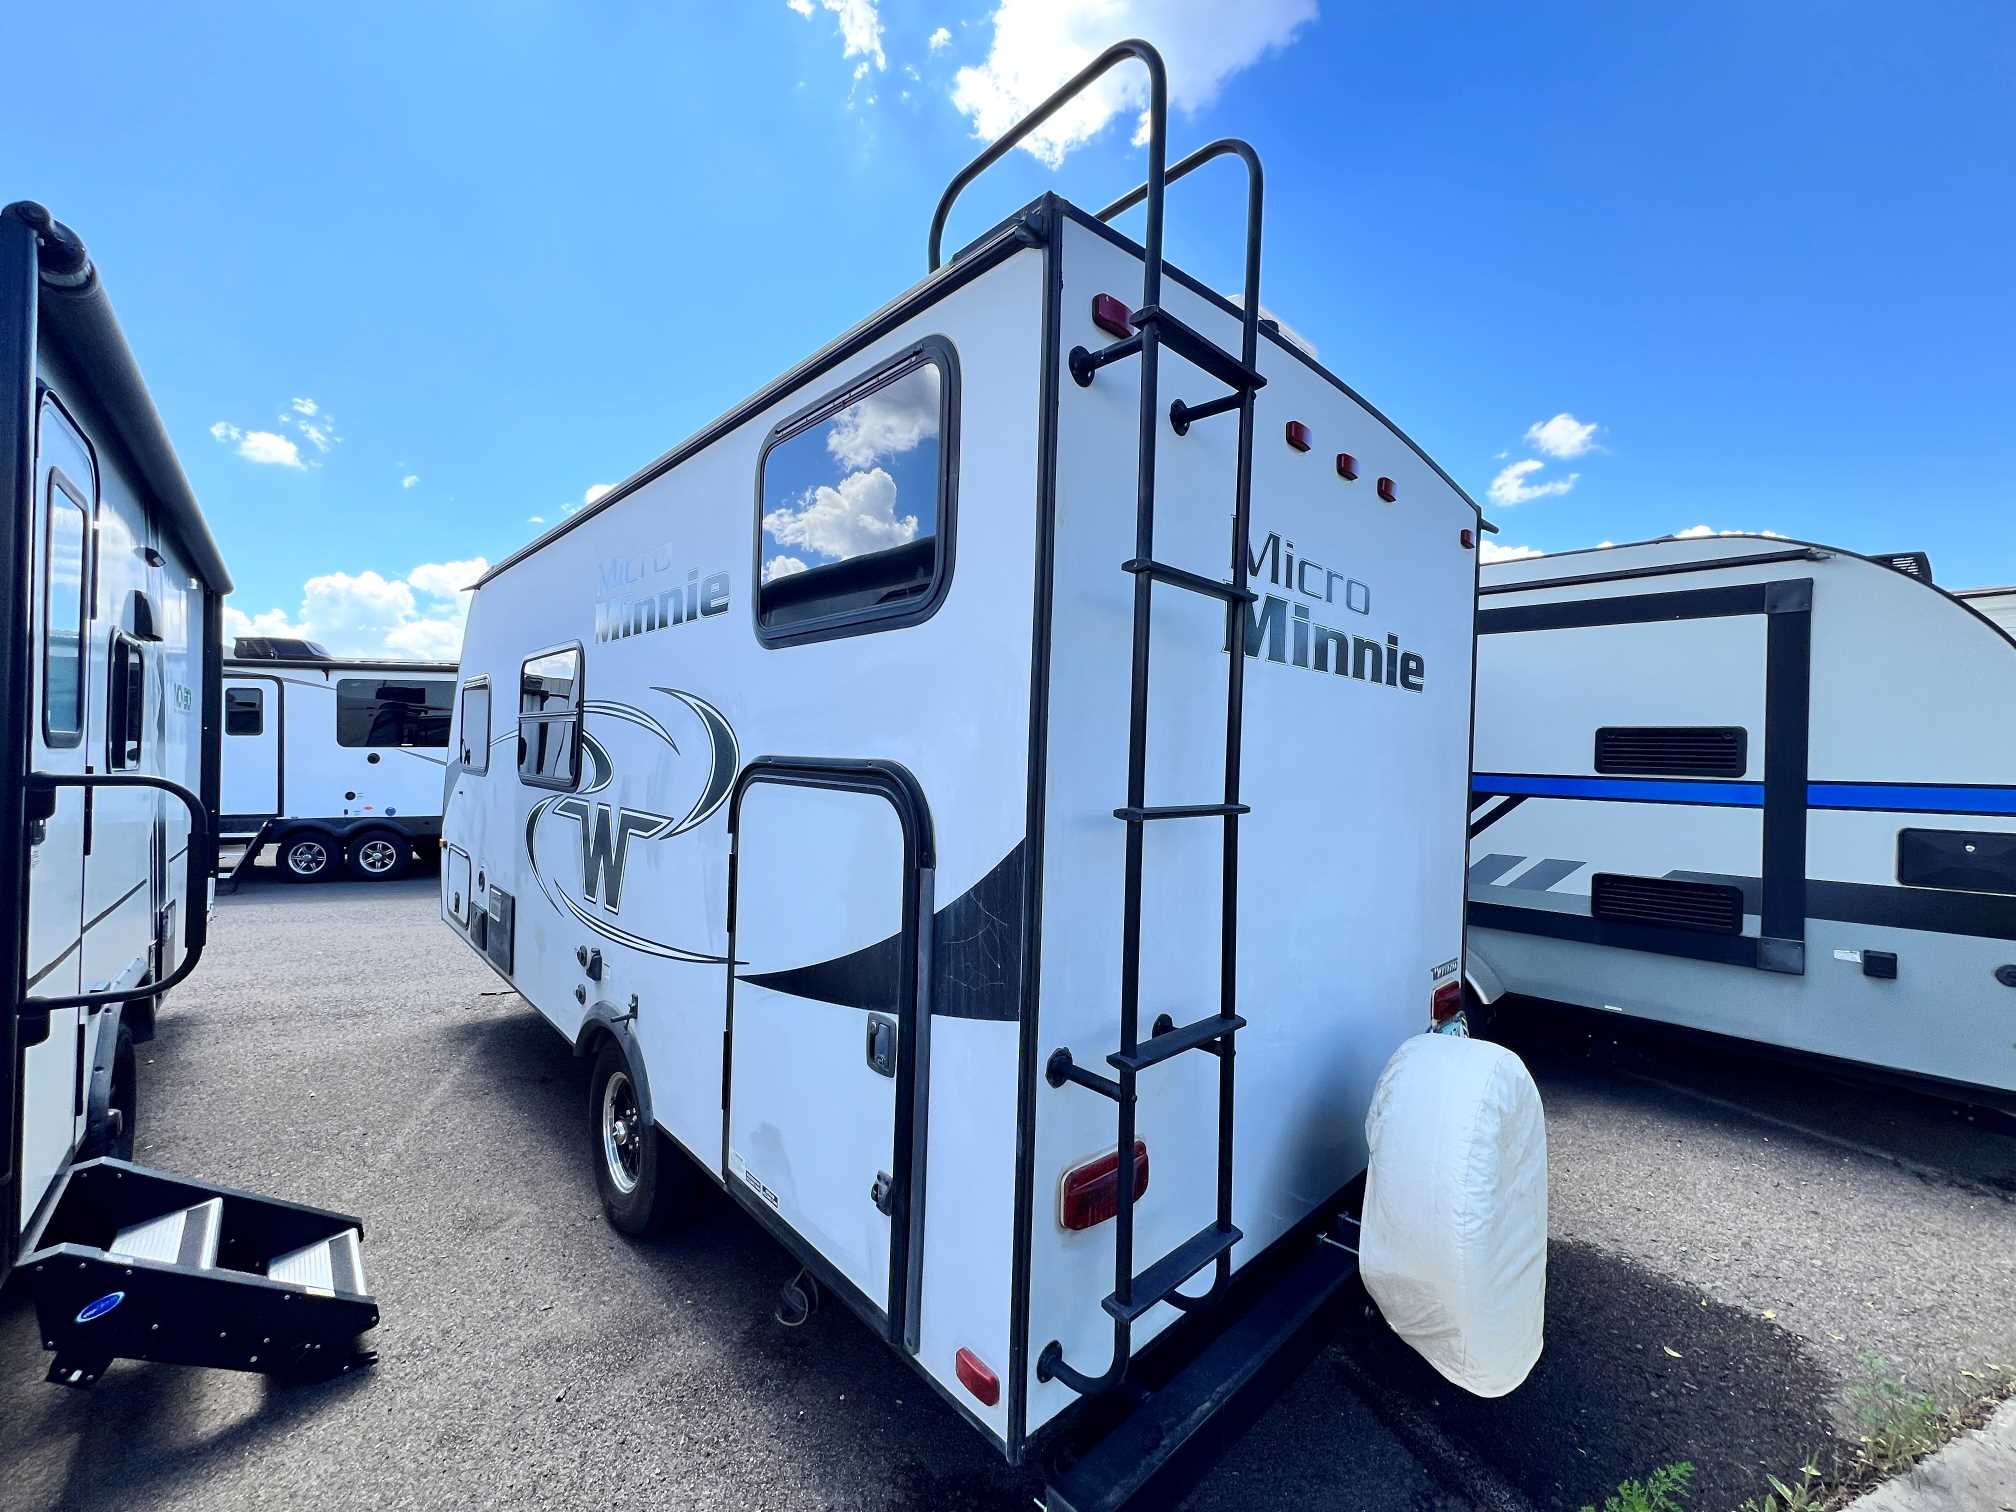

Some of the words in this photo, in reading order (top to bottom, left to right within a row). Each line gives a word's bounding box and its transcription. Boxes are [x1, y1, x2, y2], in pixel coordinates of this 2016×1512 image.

[1231, 515, 1370, 615] Micro
[1222, 580, 1425, 693] Minnie
[552, 796, 674, 916] W
